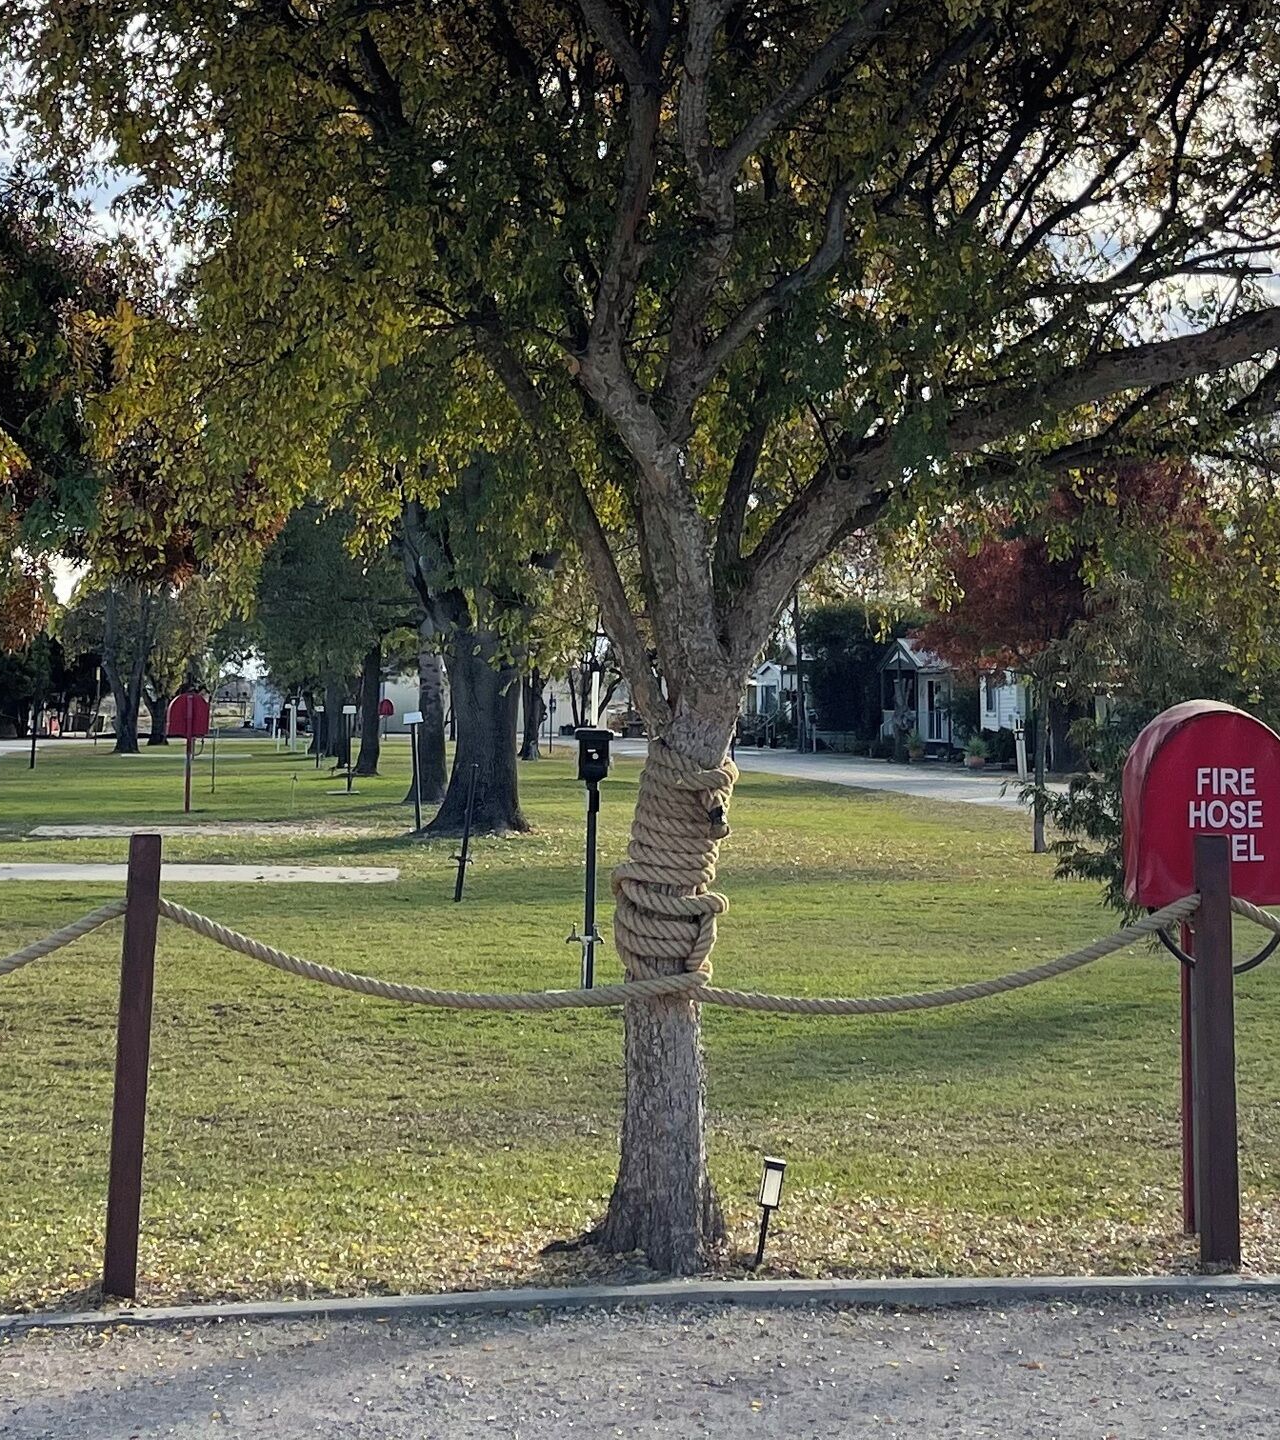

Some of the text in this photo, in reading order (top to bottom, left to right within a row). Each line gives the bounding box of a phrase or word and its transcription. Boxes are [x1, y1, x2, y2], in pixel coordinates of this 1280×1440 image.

[1197, 767, 1256, 795] FIRE
[1189, 800, 1263, 829] HOSE
[1231, 834, 1264, 861] EL
